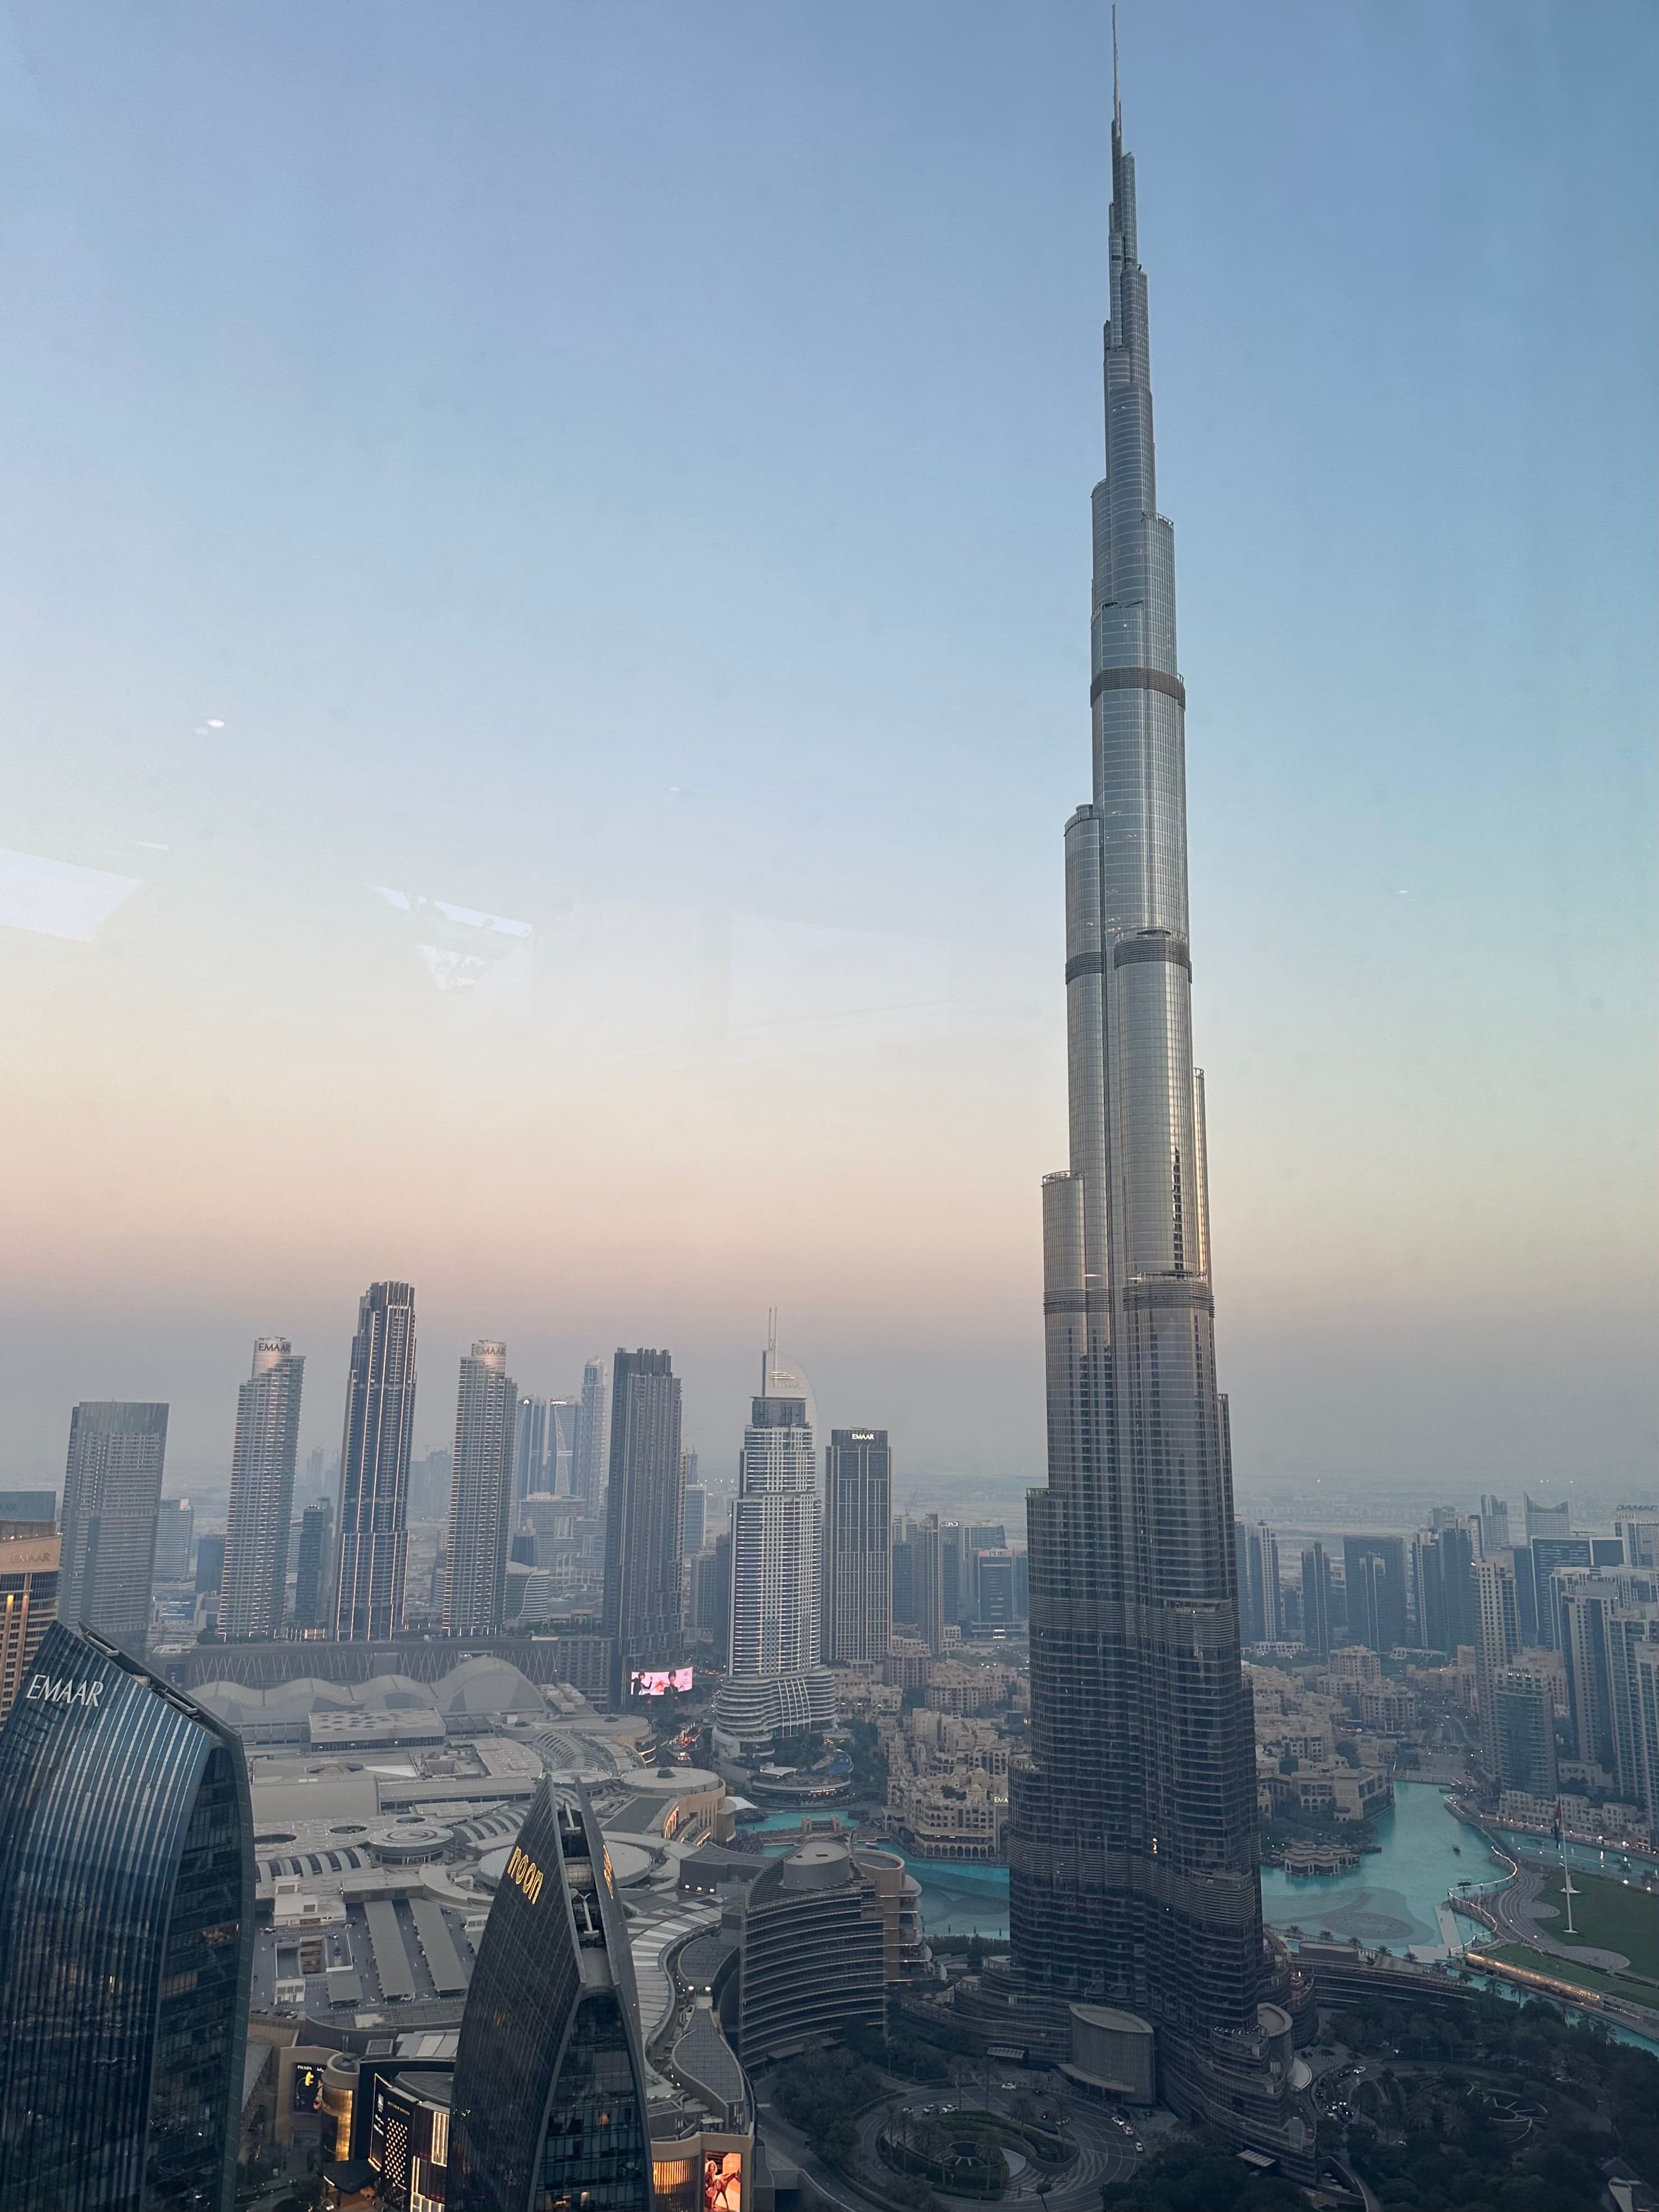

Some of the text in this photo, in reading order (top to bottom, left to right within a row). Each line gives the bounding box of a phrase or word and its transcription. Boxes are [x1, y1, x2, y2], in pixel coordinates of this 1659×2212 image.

[258, 1343, 291, 1352] EMAAR
[475, 1347, 506, 1355] EMAAR
[11, 1552, 50, 1563] EMAAR
[26, 1674, 104, 1707] EMAAR
[507, 1846, 544, 1904] noon
